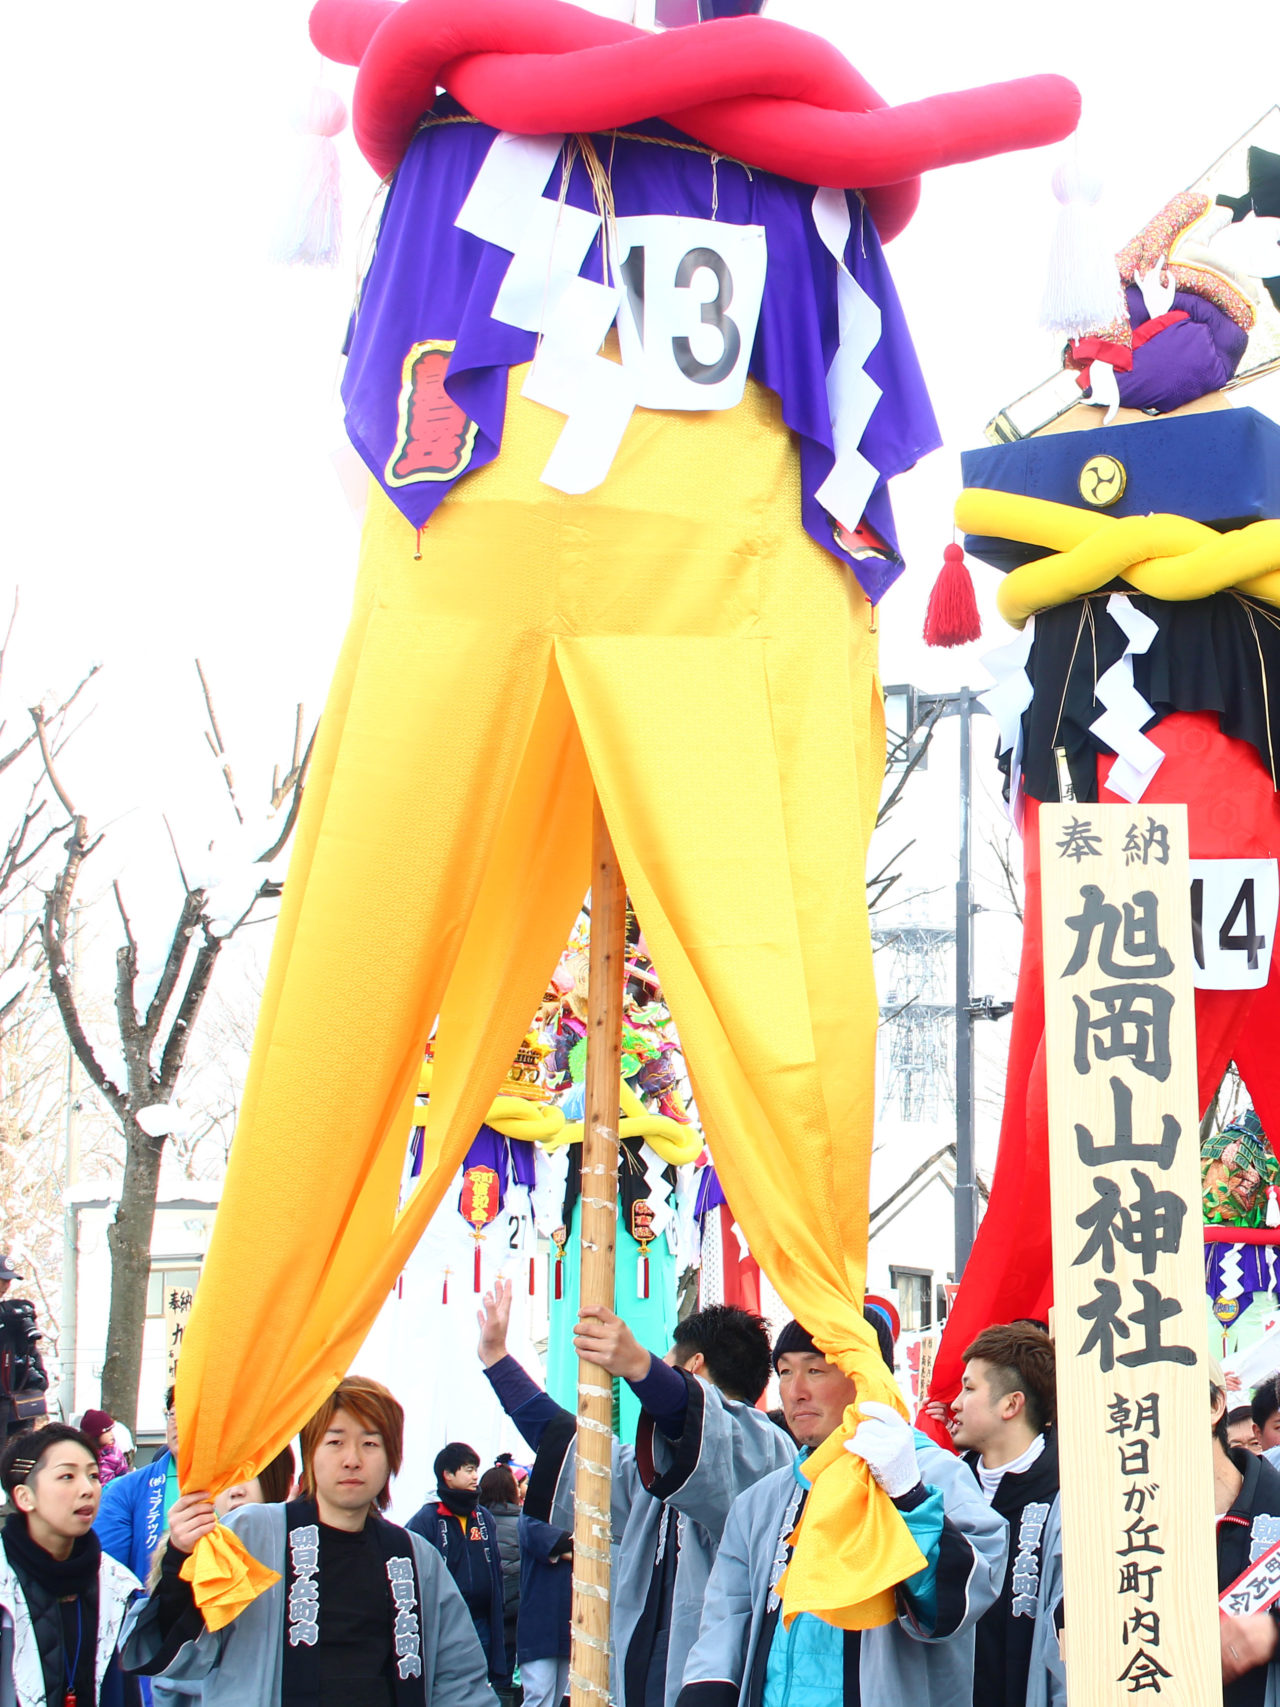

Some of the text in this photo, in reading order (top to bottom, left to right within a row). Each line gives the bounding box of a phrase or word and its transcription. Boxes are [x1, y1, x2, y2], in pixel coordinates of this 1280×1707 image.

[619, 245, 741, 385] 13
[1055, 816, 1170, 866] 奉納
[1190, 878, 1265, 970] 14
[1060, 884, 1197, 1693] 旭岡山神社 朝日が丘町内会
